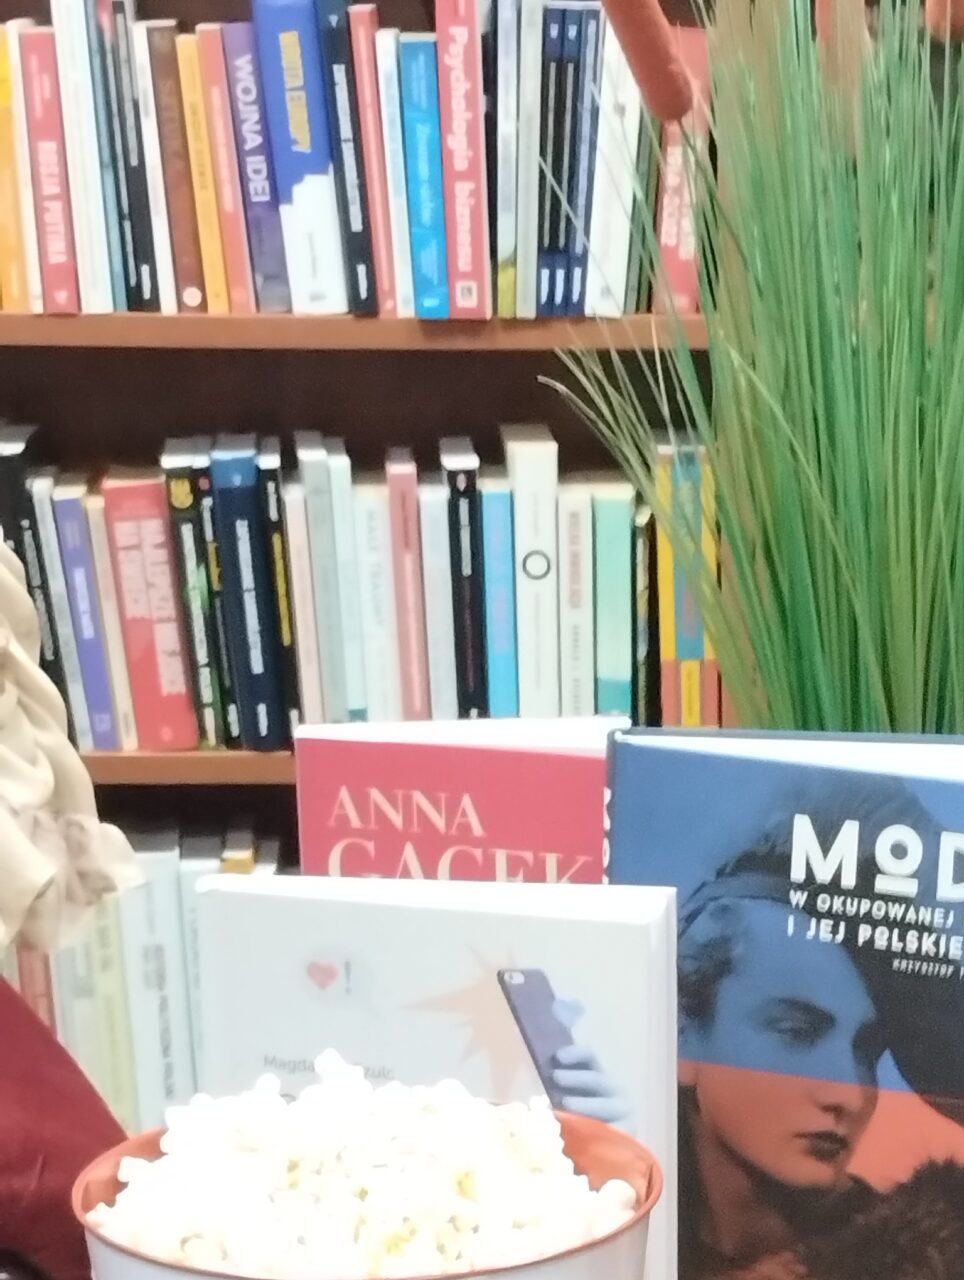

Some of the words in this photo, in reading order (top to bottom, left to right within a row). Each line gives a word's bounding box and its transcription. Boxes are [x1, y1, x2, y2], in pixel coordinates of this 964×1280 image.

[234, 55, 264, 150] WOJNA
[445, 26, 472, 171] Psychologia
[37, 141, 62, 195] ROSJA
[247, 155, 271, 203] IDEI
[42, 200, 67, 264] PUTINA
[456, 182, 477, 271] biznesu
[328, 784, 487, 838] ANNA
[788, 889, 809, 910] W
[816, 893, 955, 929] OKUPOWANEJ
[786, 914, 795, 938] I
[805, 918, 847, 944] JEJ
[857, 923, 963, 961] POLSKIE
